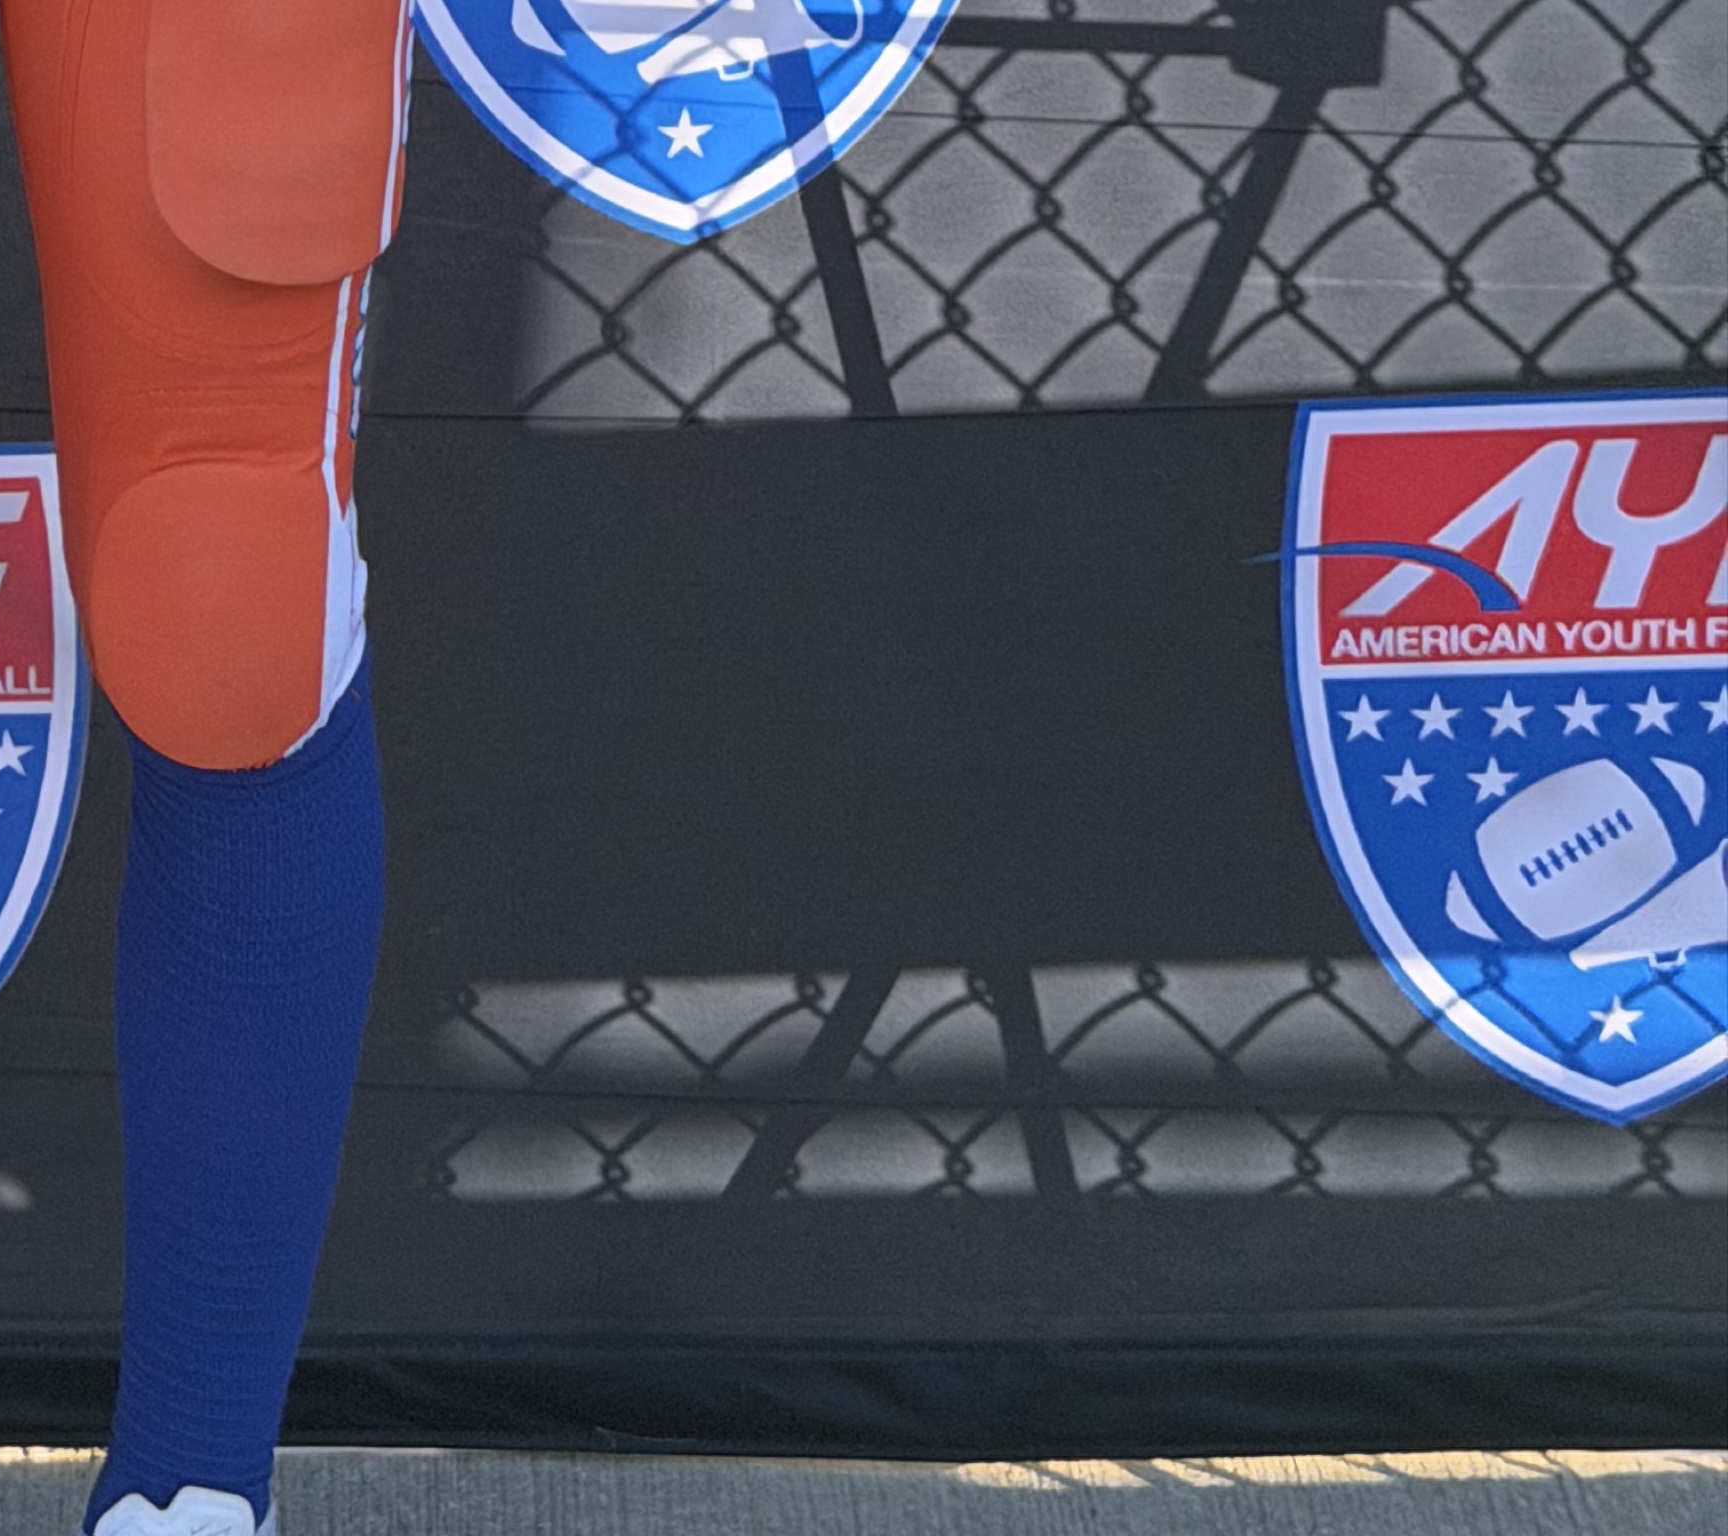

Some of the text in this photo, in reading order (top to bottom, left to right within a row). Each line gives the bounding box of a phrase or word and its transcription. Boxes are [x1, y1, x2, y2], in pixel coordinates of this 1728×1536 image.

[1338, 434, 1728, 617] AY
[1330, 621, 1547, 659] AMERICAN
[1555, 617, 1698, 651] YOUTH
